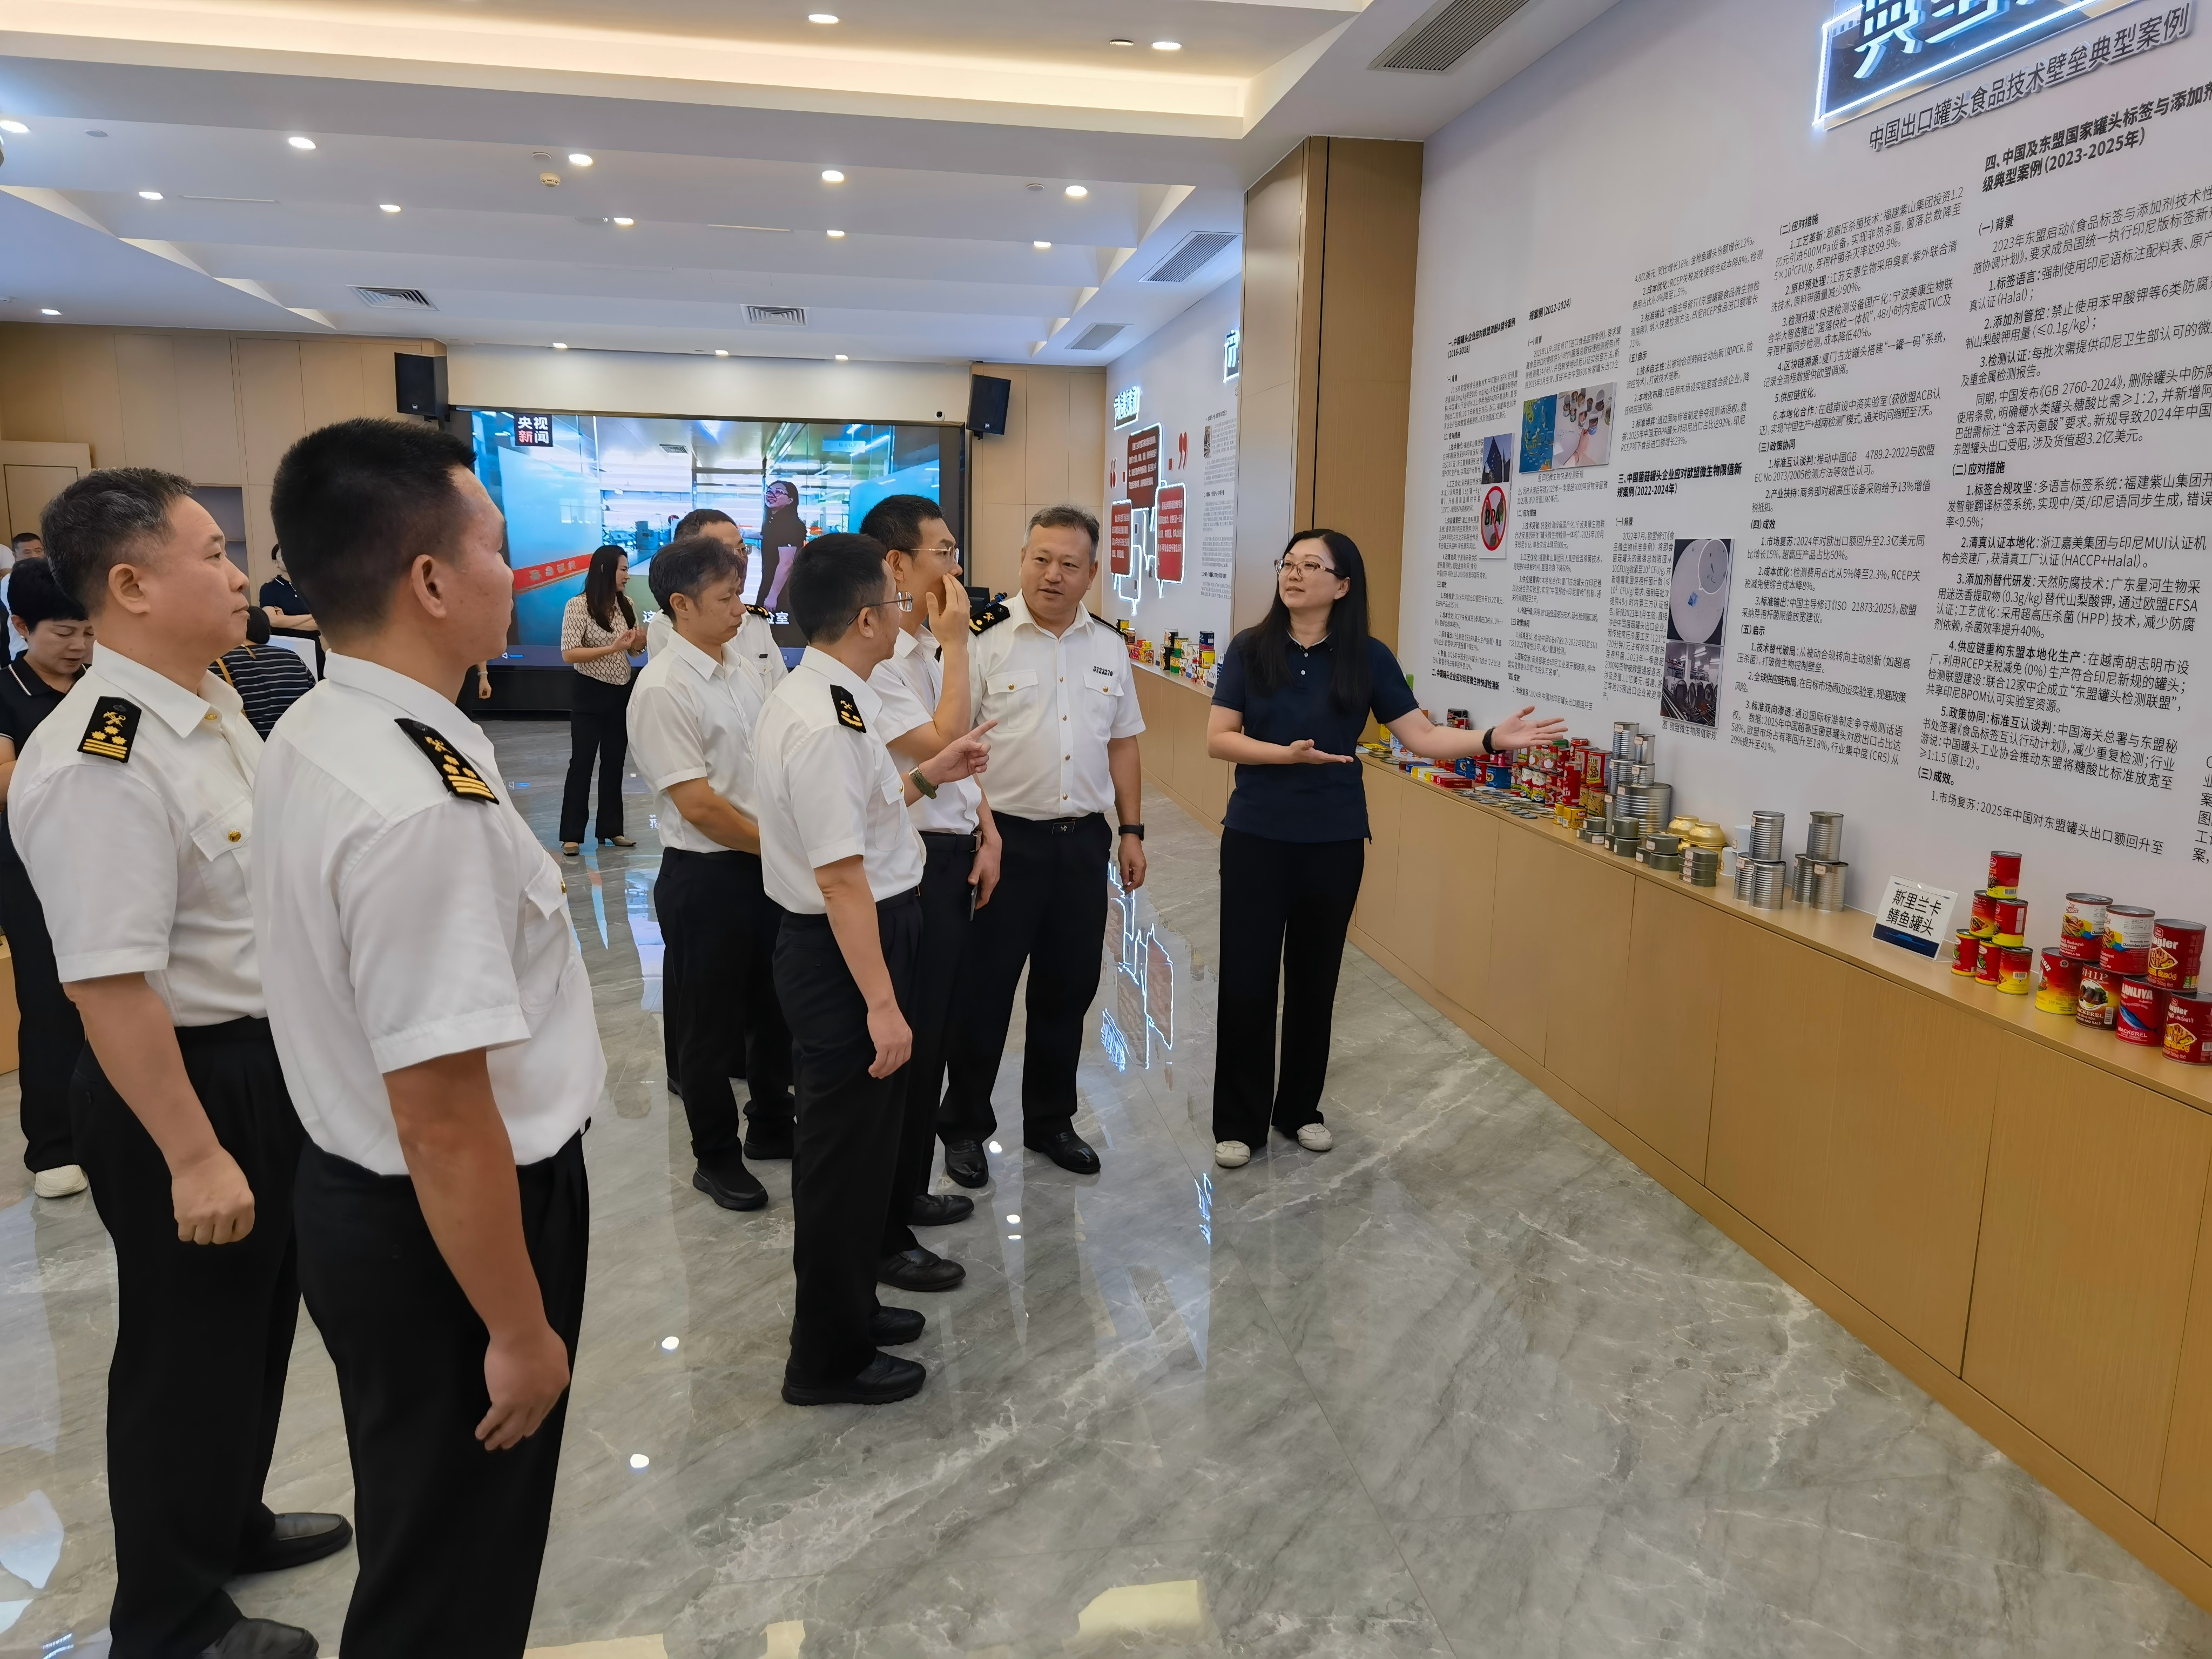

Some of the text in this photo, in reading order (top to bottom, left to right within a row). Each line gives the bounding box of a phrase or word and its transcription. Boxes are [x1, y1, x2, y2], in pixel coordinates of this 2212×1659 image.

[1869, 4, 2193, 150] 中国出口罐头食品技术壁垒典型案例
[1779, 213, 1819, 236] （二）应对措施
[1972, 206, 2212, 274] 施协调计划》，要求成员国统一执行印尼版标签新
[1984, 276, 2212, 329] 2.添加剂管控：禁止使用苯甲酸钾等6类防腐
[1980, 319, 2212, 367] 3.检测认证：每批次需提供印尼卫生部认可的微
[1960, 363, 2041, 387] 及重金属检测报告。
[517, 416, 548, 430] 央视
[518, 430, 550, 444] 新闻
[1758, 439, 1796, 453] （三）政策协同
[1755, 464, 1874, 482] EC No 2073/2005检测方法等效性认可。
[1952, 460, 2006, 476] （二）应对措施
[1485, 508, 1501, 527] BPA
[1751, 518, 1776, 530] （四）成效
[1741, 623, 1765, 636] （五）启示
[1892, 888, 1941, 916] 斯里兰卡
[1886, 907, 1934, 936] 鲭鱼罐头
[2082, 968, 2108, 982] SHIP
